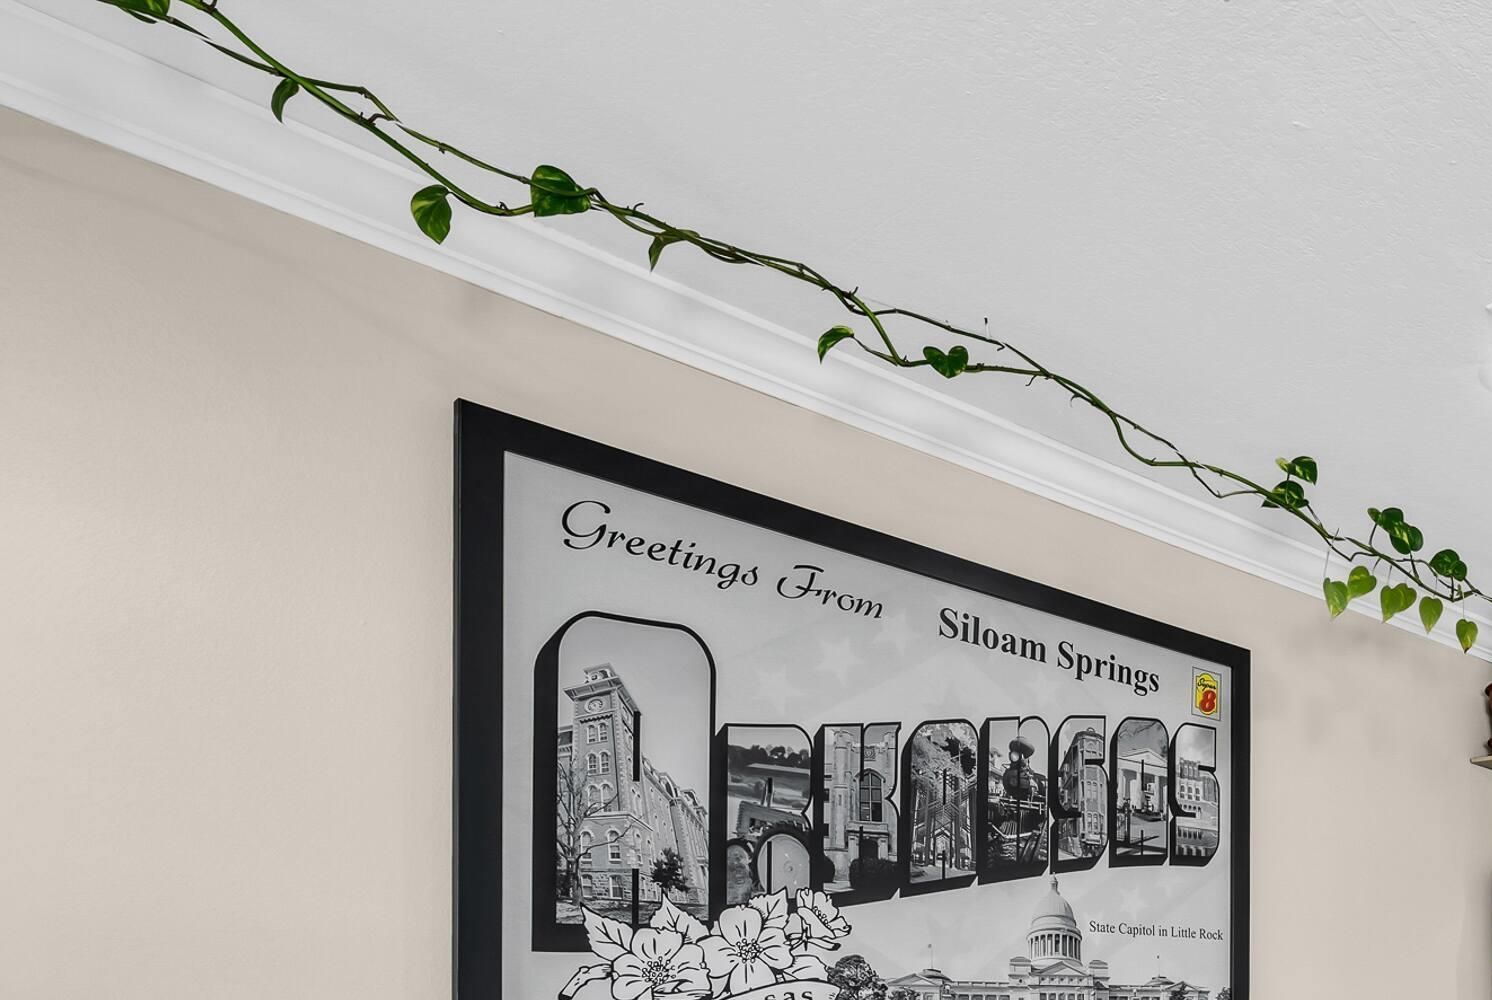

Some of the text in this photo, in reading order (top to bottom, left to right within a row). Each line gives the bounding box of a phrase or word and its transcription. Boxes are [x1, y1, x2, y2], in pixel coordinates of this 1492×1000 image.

[561, 500, 884, 619] Greetings From
[938, 607, 1160, 697] Siloam Springs
[1200, 689, 1217, 713] 8
[1089, 920, 1223, 941] State Capitol in Little Rock
